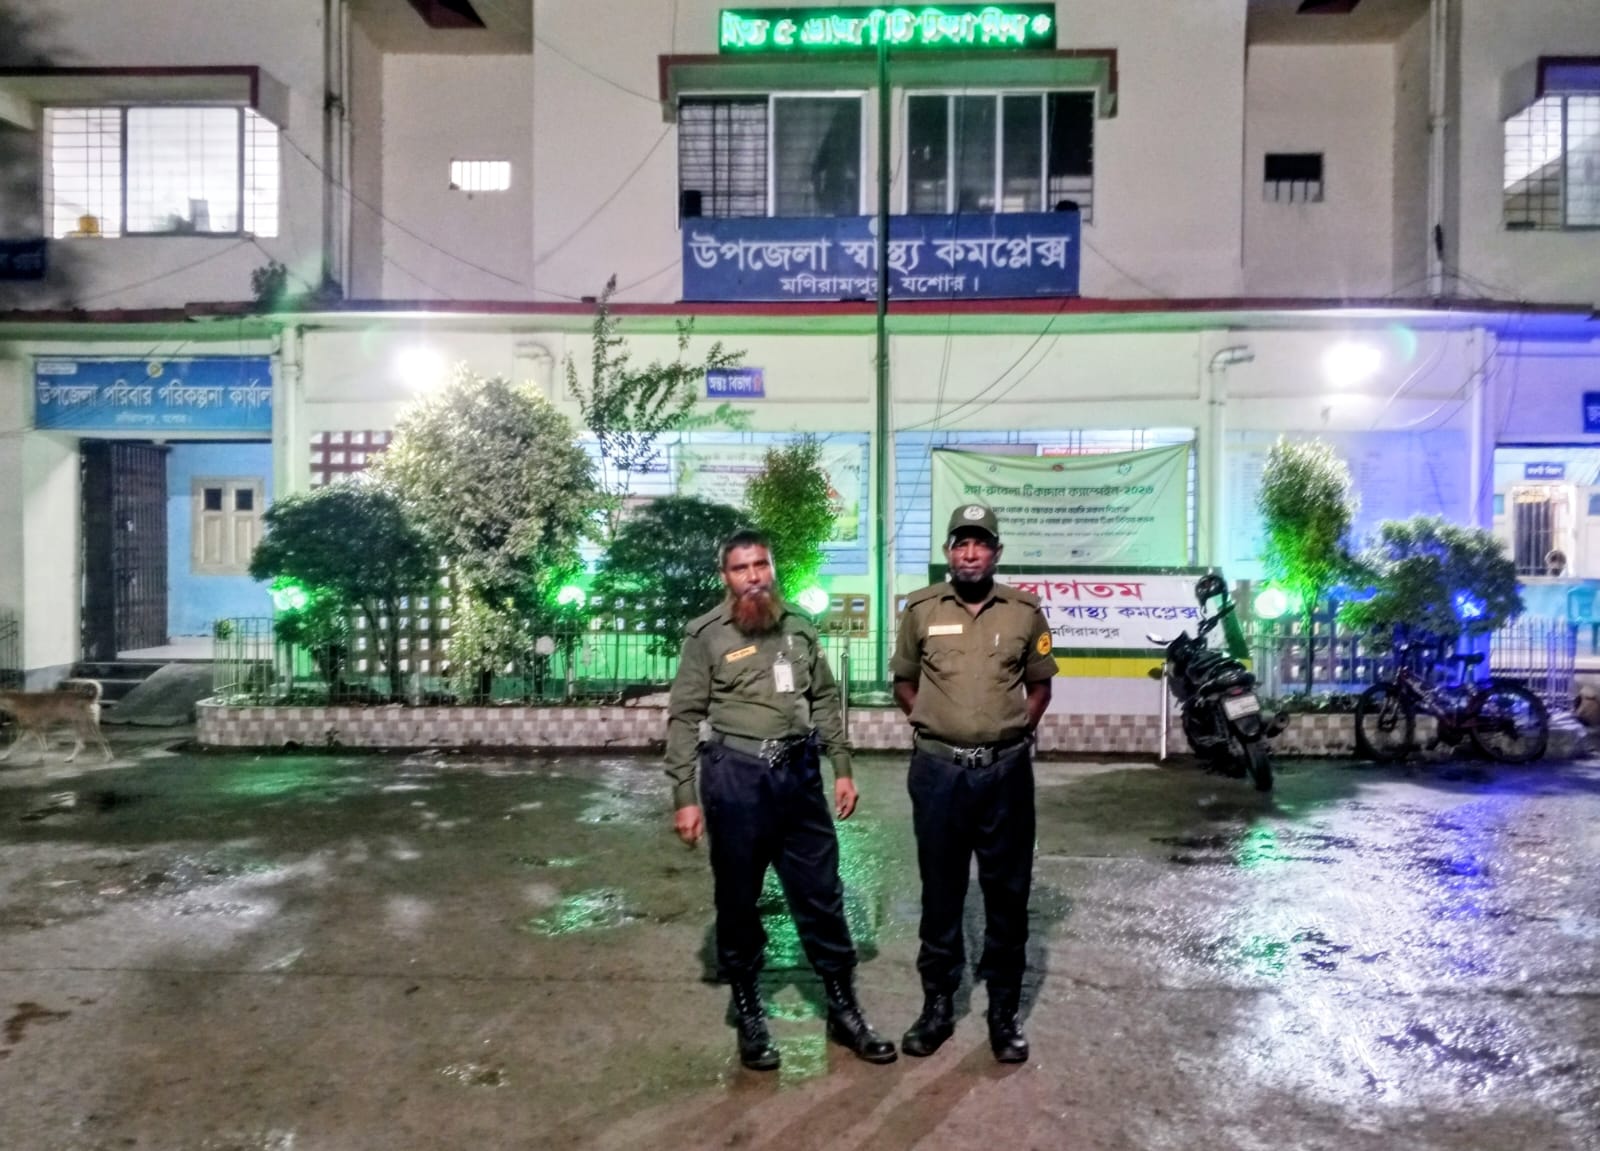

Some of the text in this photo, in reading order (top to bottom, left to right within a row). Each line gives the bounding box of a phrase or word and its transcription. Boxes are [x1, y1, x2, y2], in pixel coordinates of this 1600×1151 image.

[688, 231, 832, 272] উপজেলা
[932, 234, 1071, 269] কমপ্লেক্স
[37, 380, 98, 407] উপজেলা
[103, 378, 153, 408] পরিবার
[228, 377, 272, 408] কার্যাল
[1009, 580, 1145, 601] স্বাগতম
[1057, 605, 1109, 622] স্বাস্থ্য
[1117, 605, 1200, 621] কমপ্লেক্স
